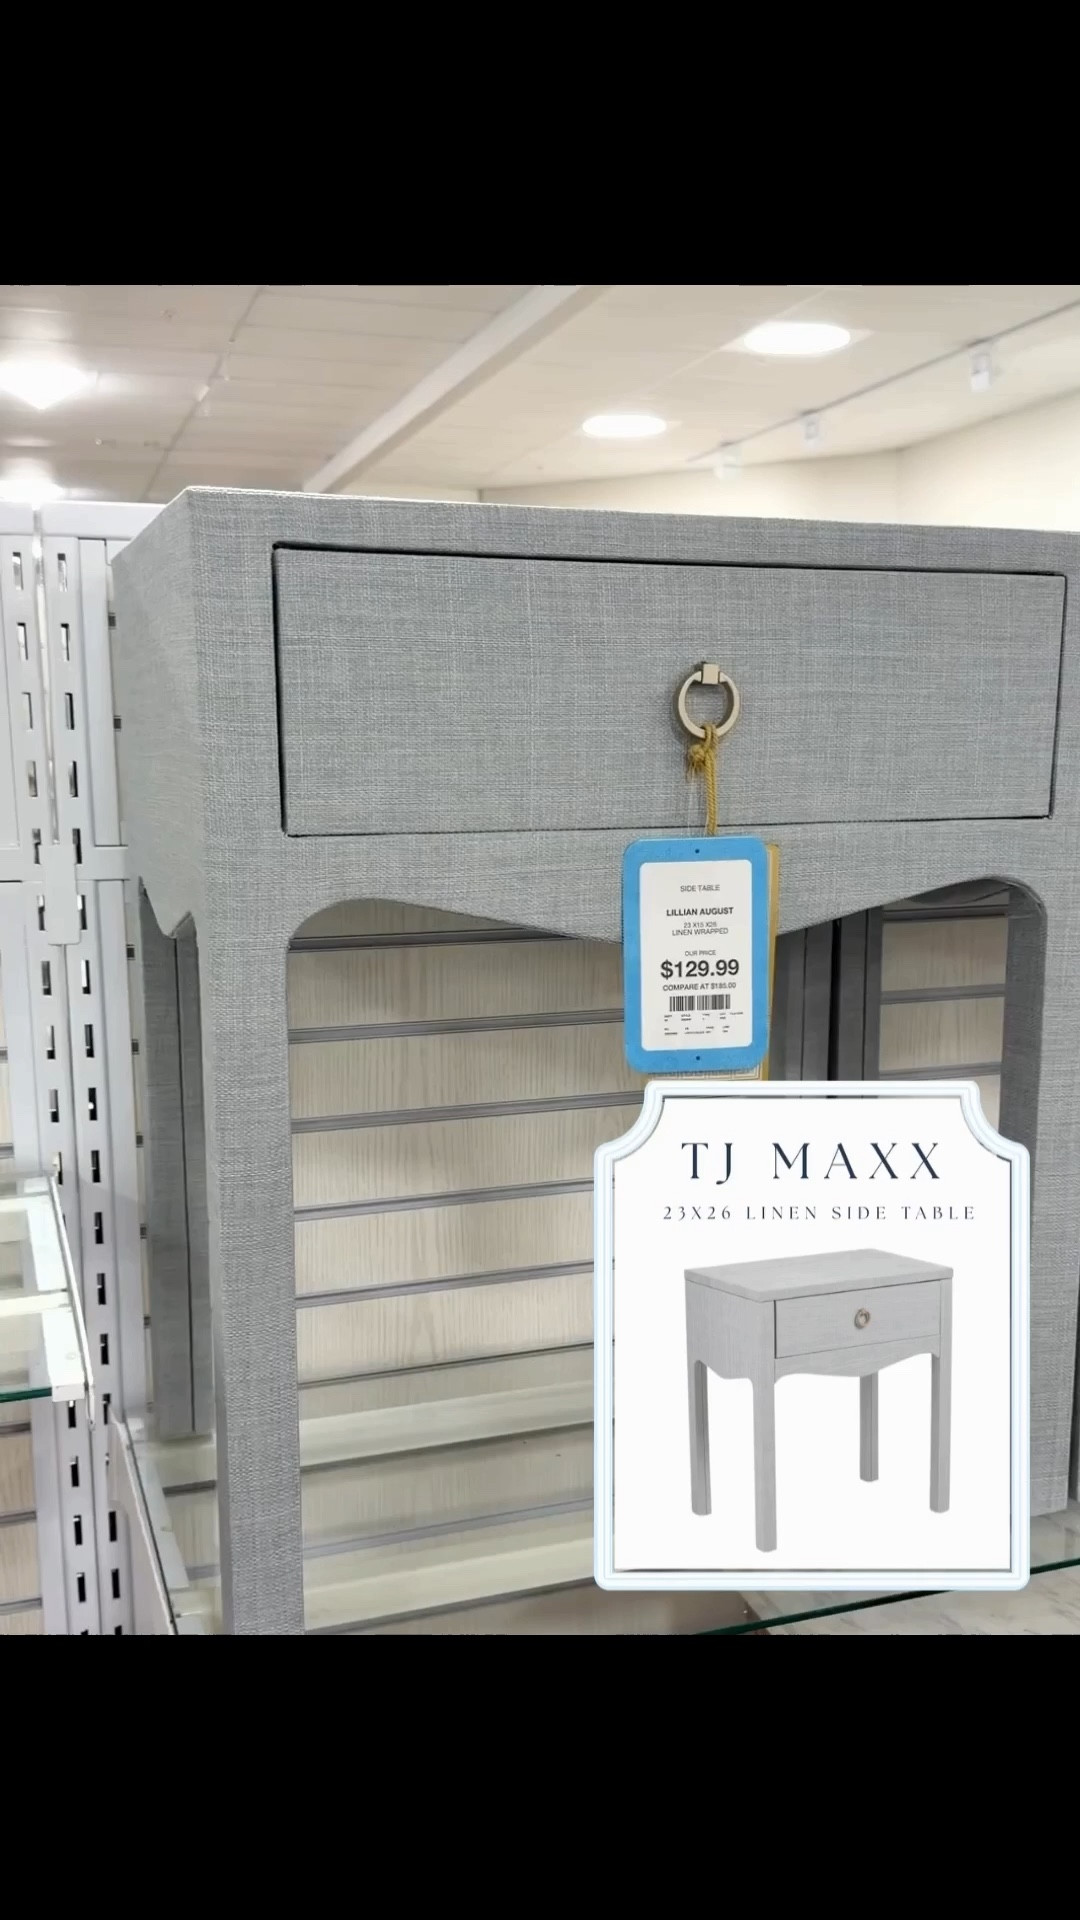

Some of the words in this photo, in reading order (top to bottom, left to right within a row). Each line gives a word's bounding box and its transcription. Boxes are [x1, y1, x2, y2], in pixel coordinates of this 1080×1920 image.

[666, 908, 698, 916] LILLIAN
[699, 907, 734, 915] AUGUST
[660, 959, 739, 980] $129.99
